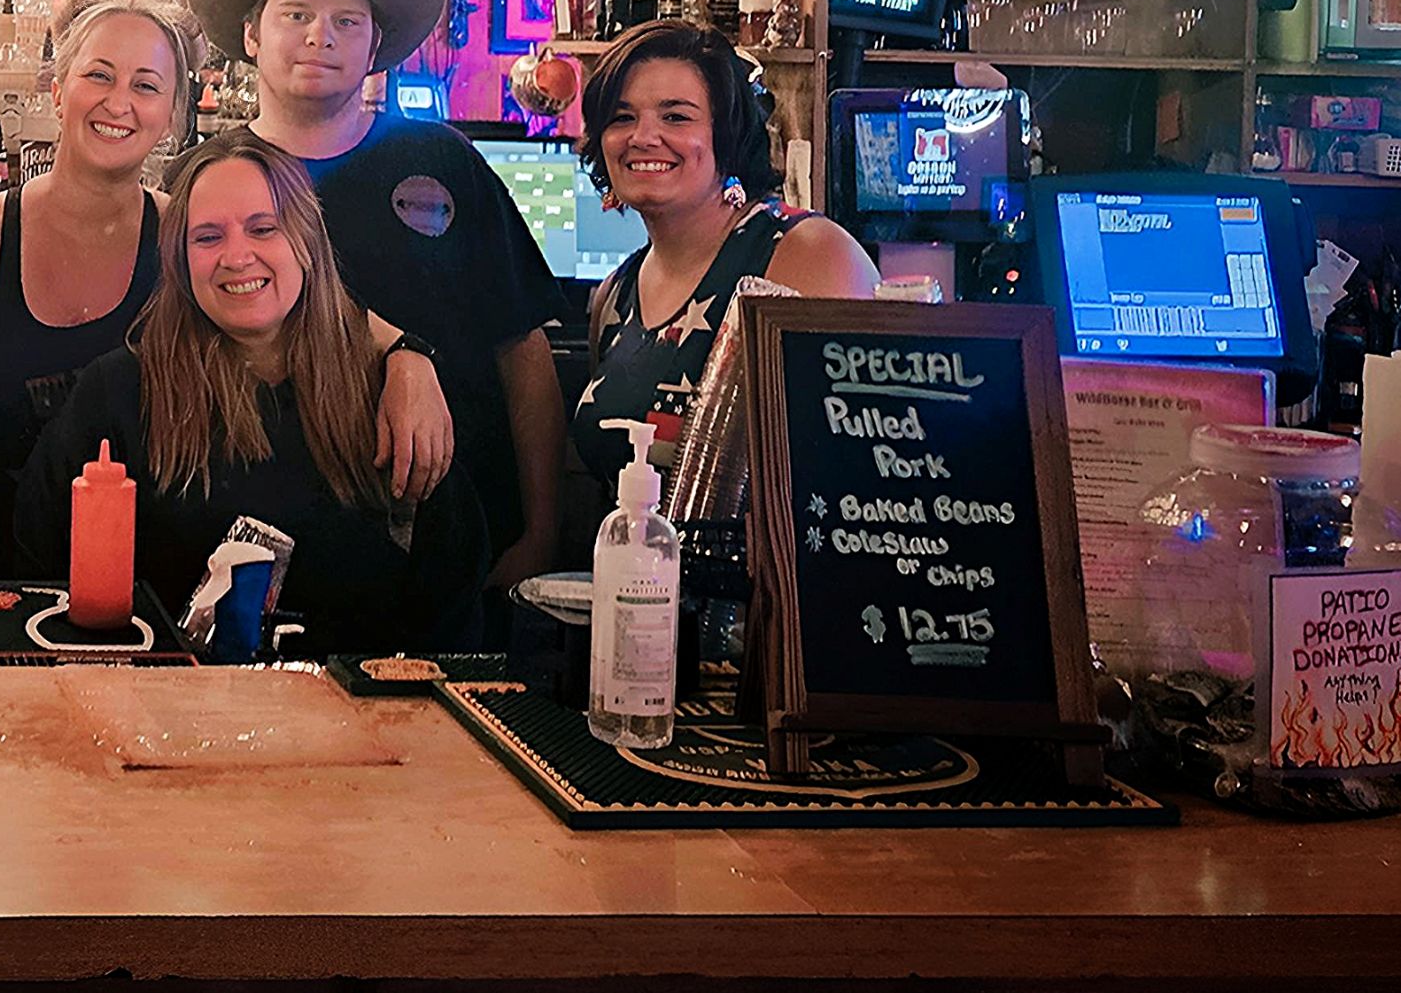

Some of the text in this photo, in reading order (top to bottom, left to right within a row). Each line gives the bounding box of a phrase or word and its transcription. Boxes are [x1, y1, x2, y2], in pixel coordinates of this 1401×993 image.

[823, 342, 984, 386] SPECIAL
[823, 396, 926, 440] Pulled
[872, 445, 951, 477] Pork
[839, 494, 1016, 525] Baked Beans
[897, 557, 920, 575] or
[1321, 588, 1389, 617] PATIO
[1303, 612, 1401, 646] PROPANE
